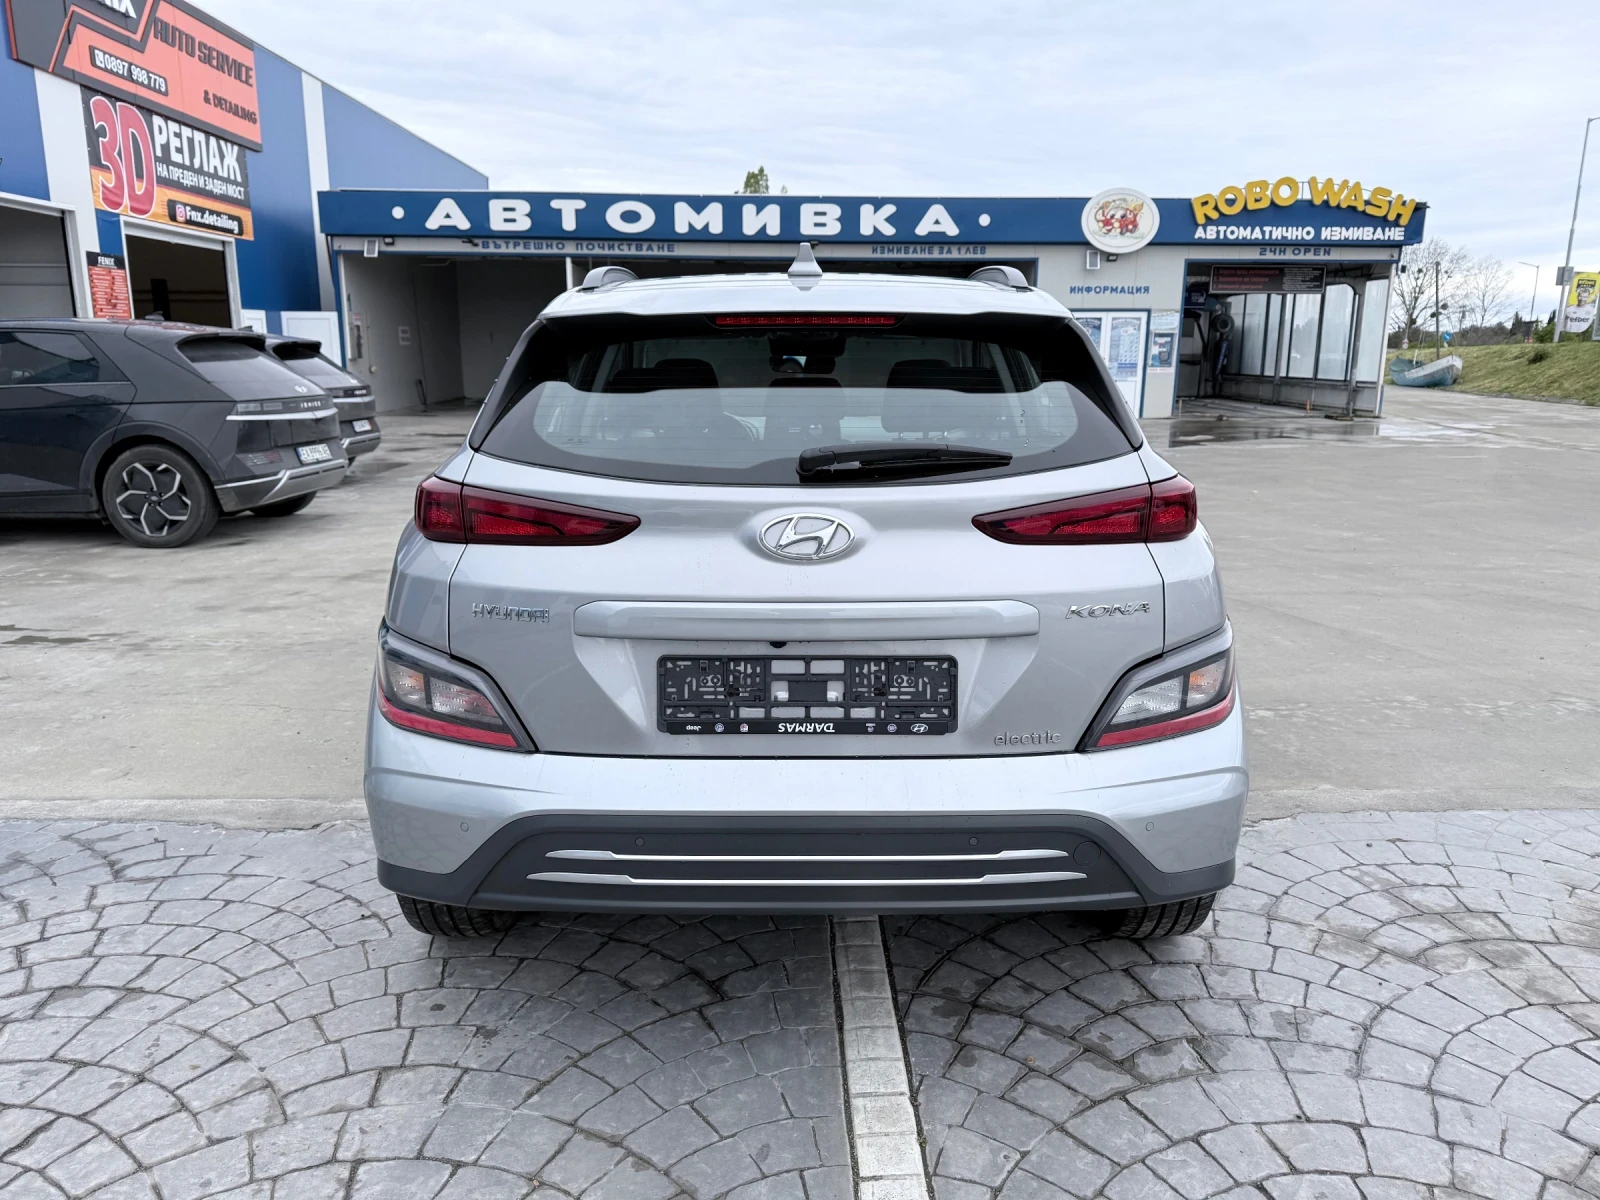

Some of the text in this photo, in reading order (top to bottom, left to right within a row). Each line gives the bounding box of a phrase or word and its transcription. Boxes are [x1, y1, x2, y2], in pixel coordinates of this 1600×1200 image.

[154, 17, 253, 87] AUTO SERVICE
[104, 54, 166, 92] 0897 998 779
[203, 90, 258, 124] & DETAILING
[90, 95, 157, 218] 3D
[152, 114, 242, 183] РЕГЛАЖ
[156, 161, 244, 200] НА ПРЕДЕН И ЗАДЕН МОСТ
[1191, 176, 1417, 226] ROBO WASH
[424, 198, 960, 237] АВТОМИВКА
[1194, 225, 1405, 241] АВТОМАТИЧНО ИЗМИВАНЕ
[481, 240, 676, 253] ВЪТРЕШНО ПОЧИСТВАНЕ
[871, 245, 934, 255] ИЗМИВАНЕ
[938, 245, 952, 255] ЗА
[965, 245, 987, 255] ЛЕВ
[1259, 247, 1331, 256] 24H OPEN
[1069, 285, 1150, 295] ИНФОРМАЦИЯ
[472, 602, 550, 623] HYUNDAI
[1065, 601, 1150, 619] KONA
[777, 722, 836, 732] DARMAS
[994, 730, 1061, 746] electric
